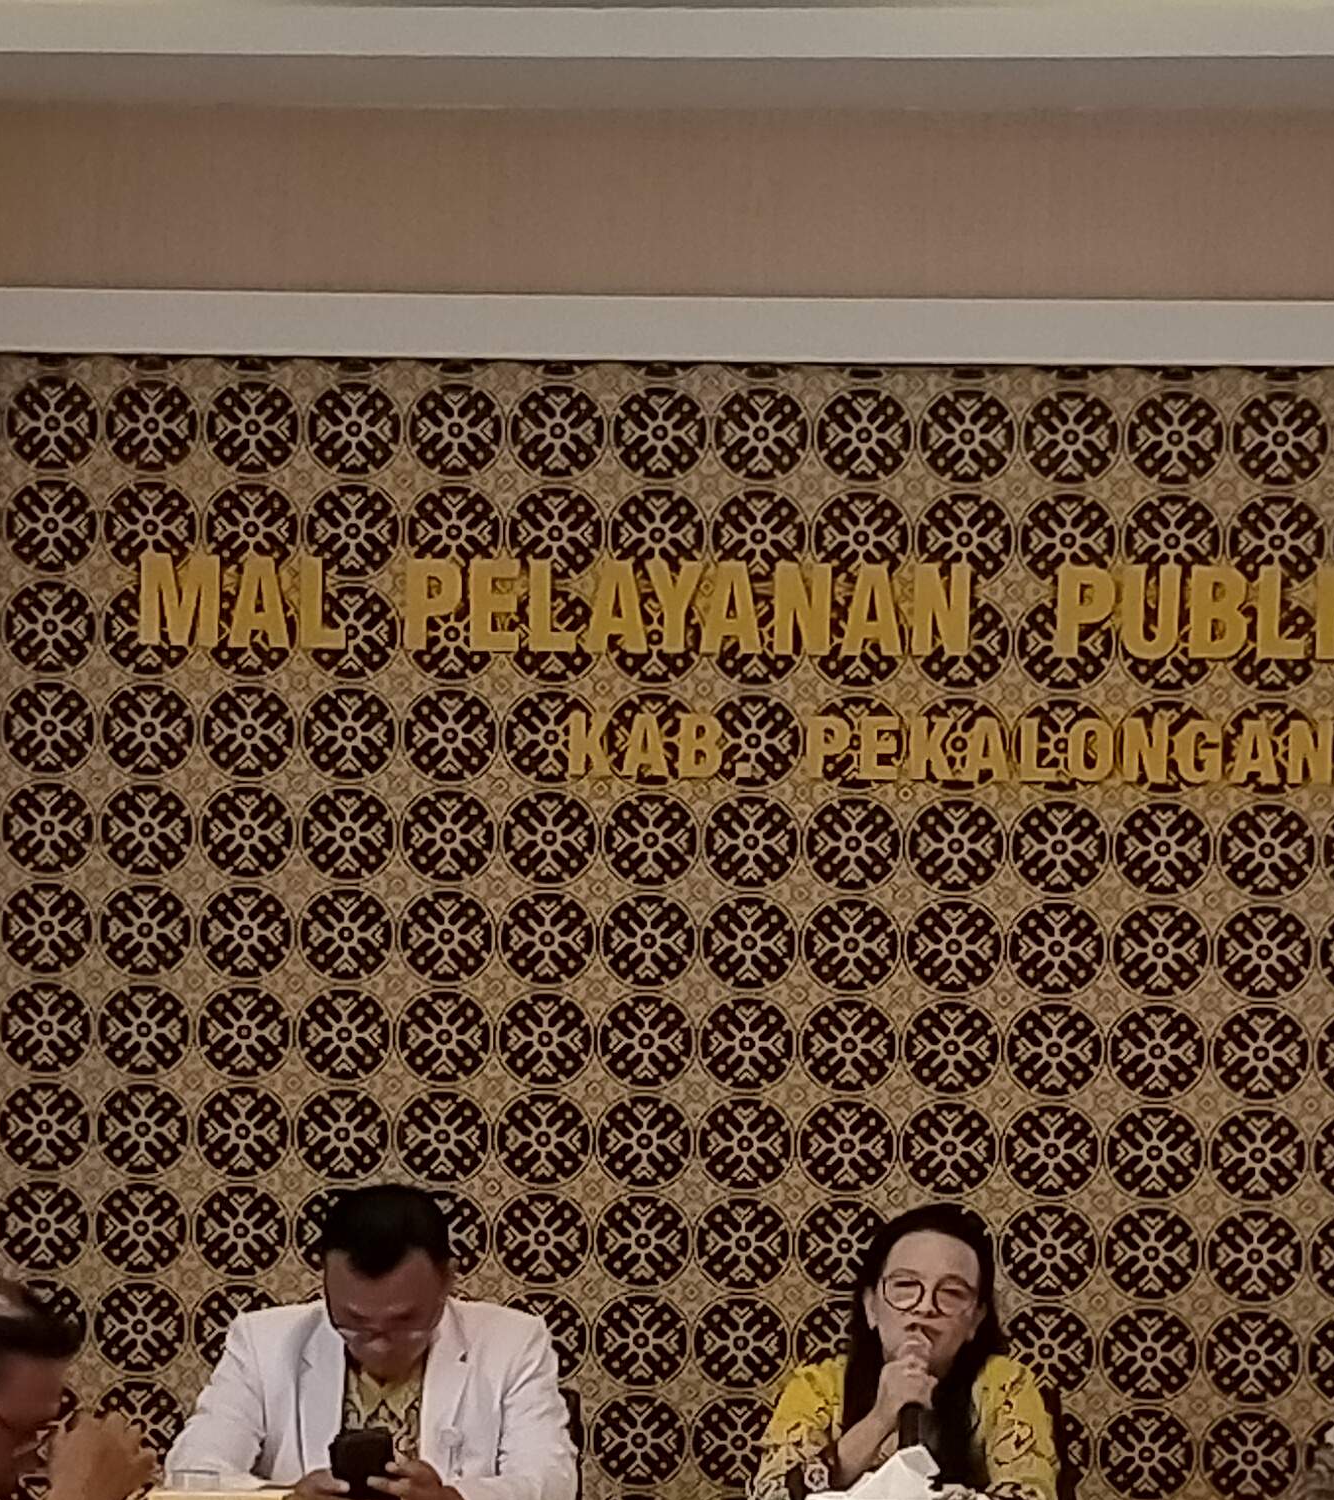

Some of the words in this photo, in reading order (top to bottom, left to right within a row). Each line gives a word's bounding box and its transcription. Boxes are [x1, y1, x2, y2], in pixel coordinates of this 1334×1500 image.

[139, 552, 348, 649] MAL
[404, 557, 971, 657] PELAYANAN
[805, 715, 1334, 786] PEKALONGAN
